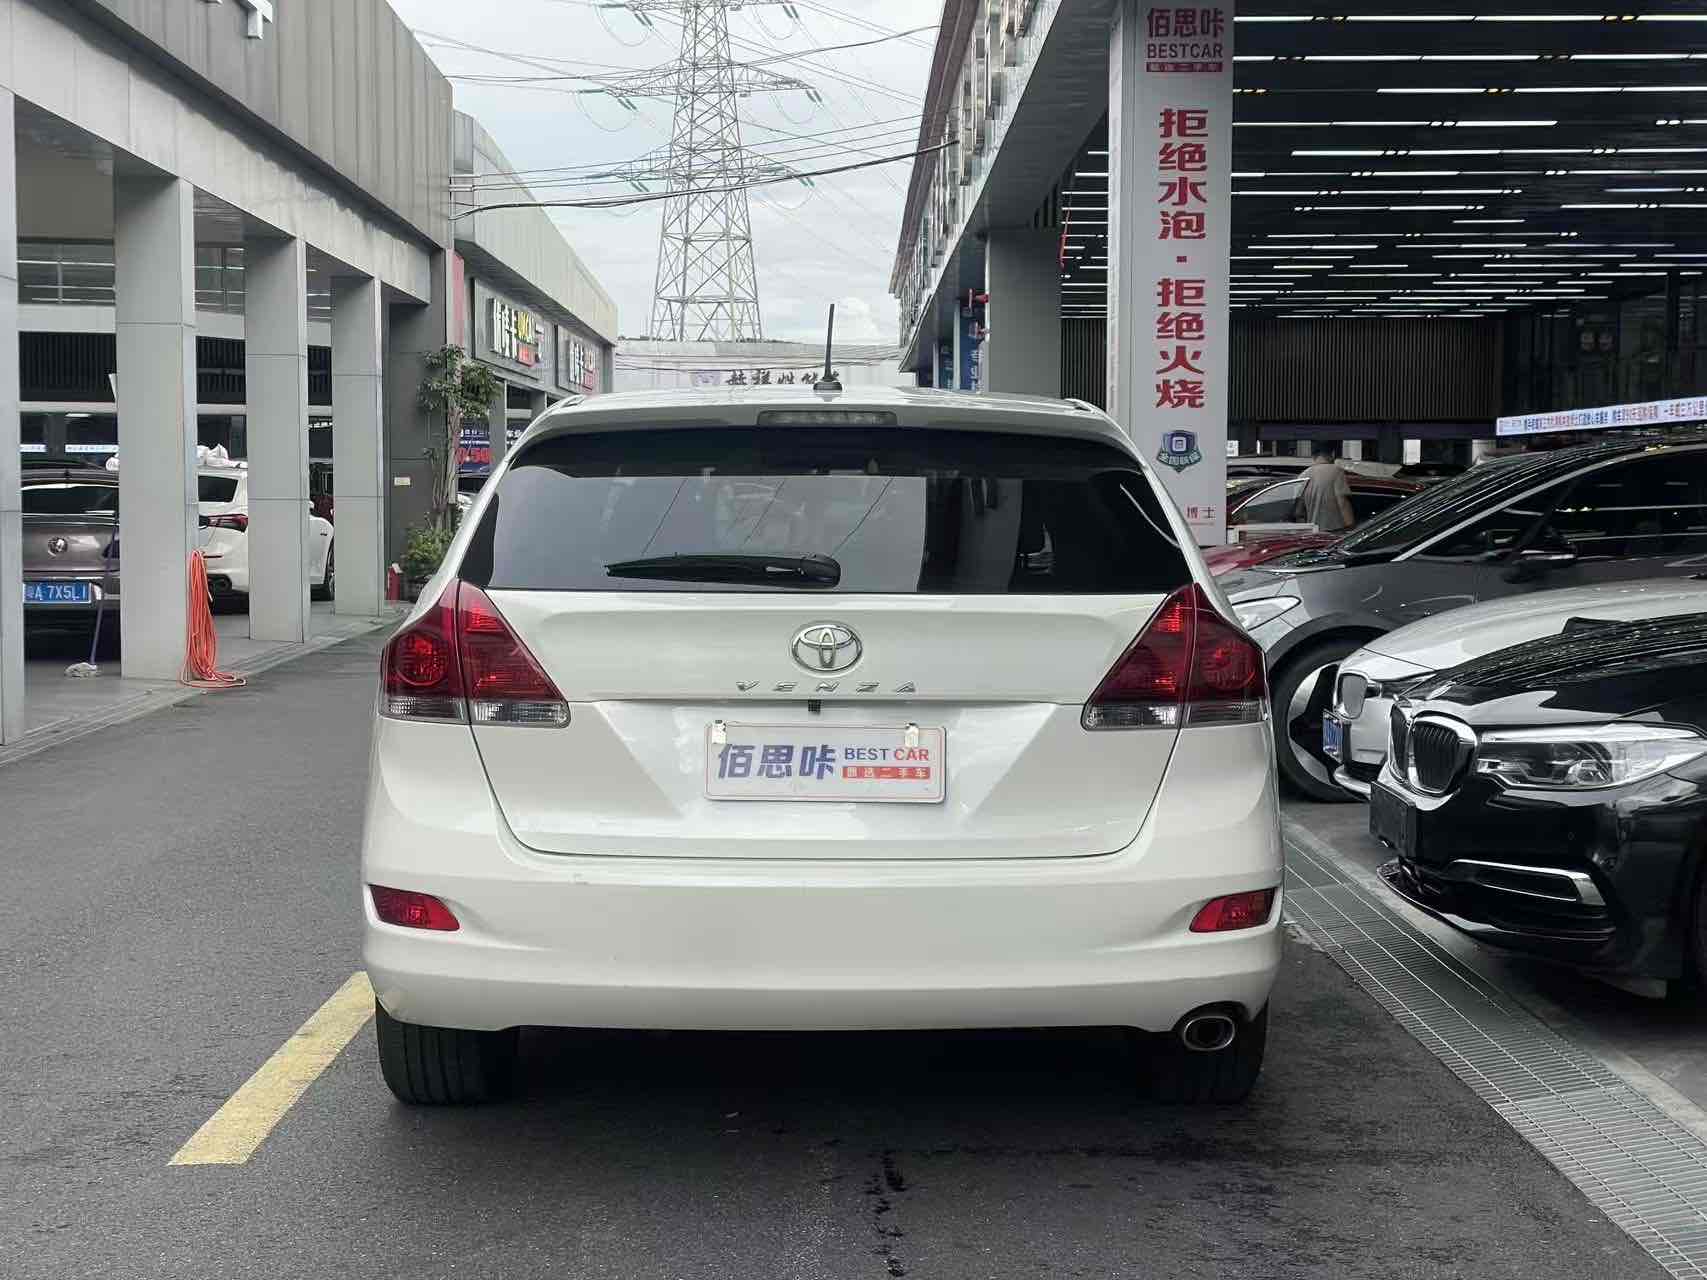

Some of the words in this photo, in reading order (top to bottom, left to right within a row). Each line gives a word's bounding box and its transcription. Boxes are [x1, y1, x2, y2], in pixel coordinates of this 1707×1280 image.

[1147, 7, 1225, 38] 佰思咔
[1147, 43, 1223, 59] BESTCAR
[736, 680, 917, 693] VENZA
[718, 743, 836, 780] 佰思咔
[844, 747, 889, 761] BEST
[893, 748, 929, 761] CAR
